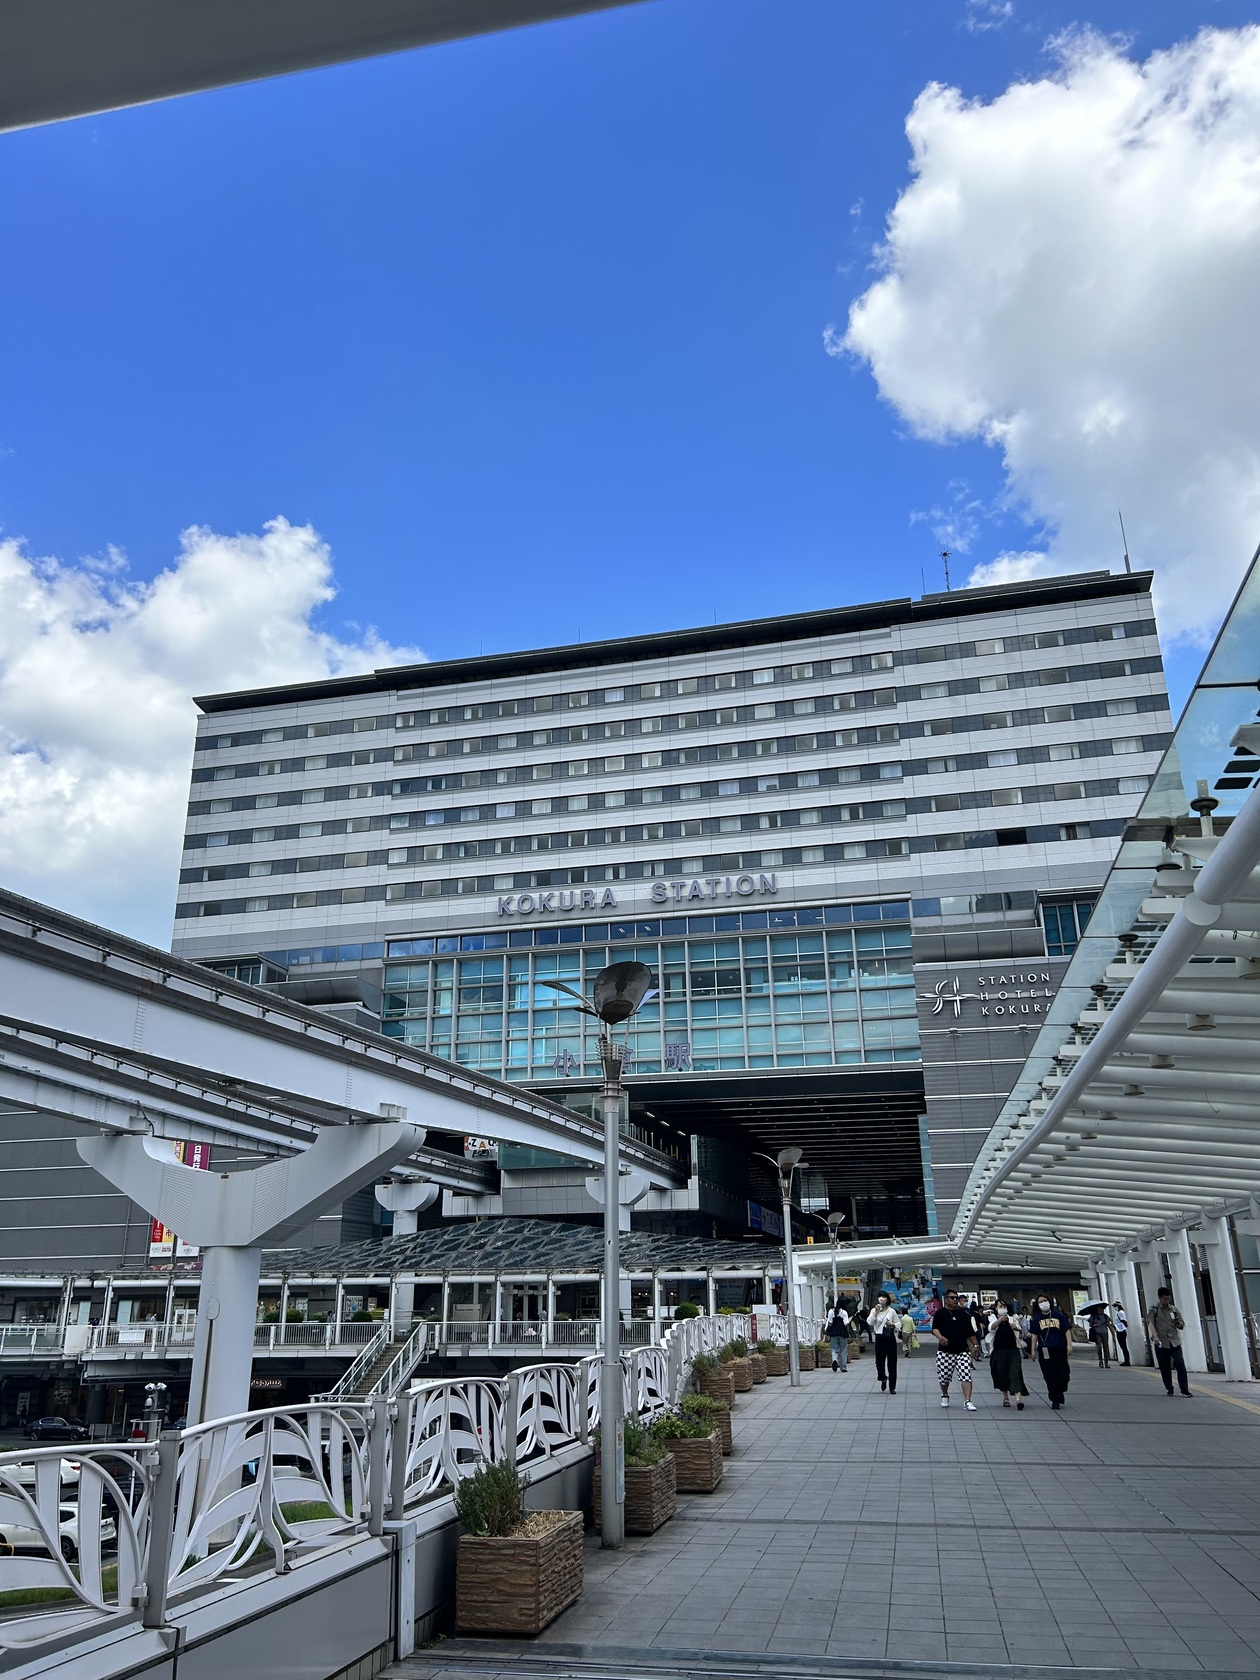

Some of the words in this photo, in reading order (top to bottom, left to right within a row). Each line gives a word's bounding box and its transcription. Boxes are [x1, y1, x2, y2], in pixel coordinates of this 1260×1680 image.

[497, 887, 618, 916] KOKURA
[651, 873, 778, 904] STATION
[978, 972, 1050, 986] STATION
[980, 988, 1052, 1001] HOTEL
